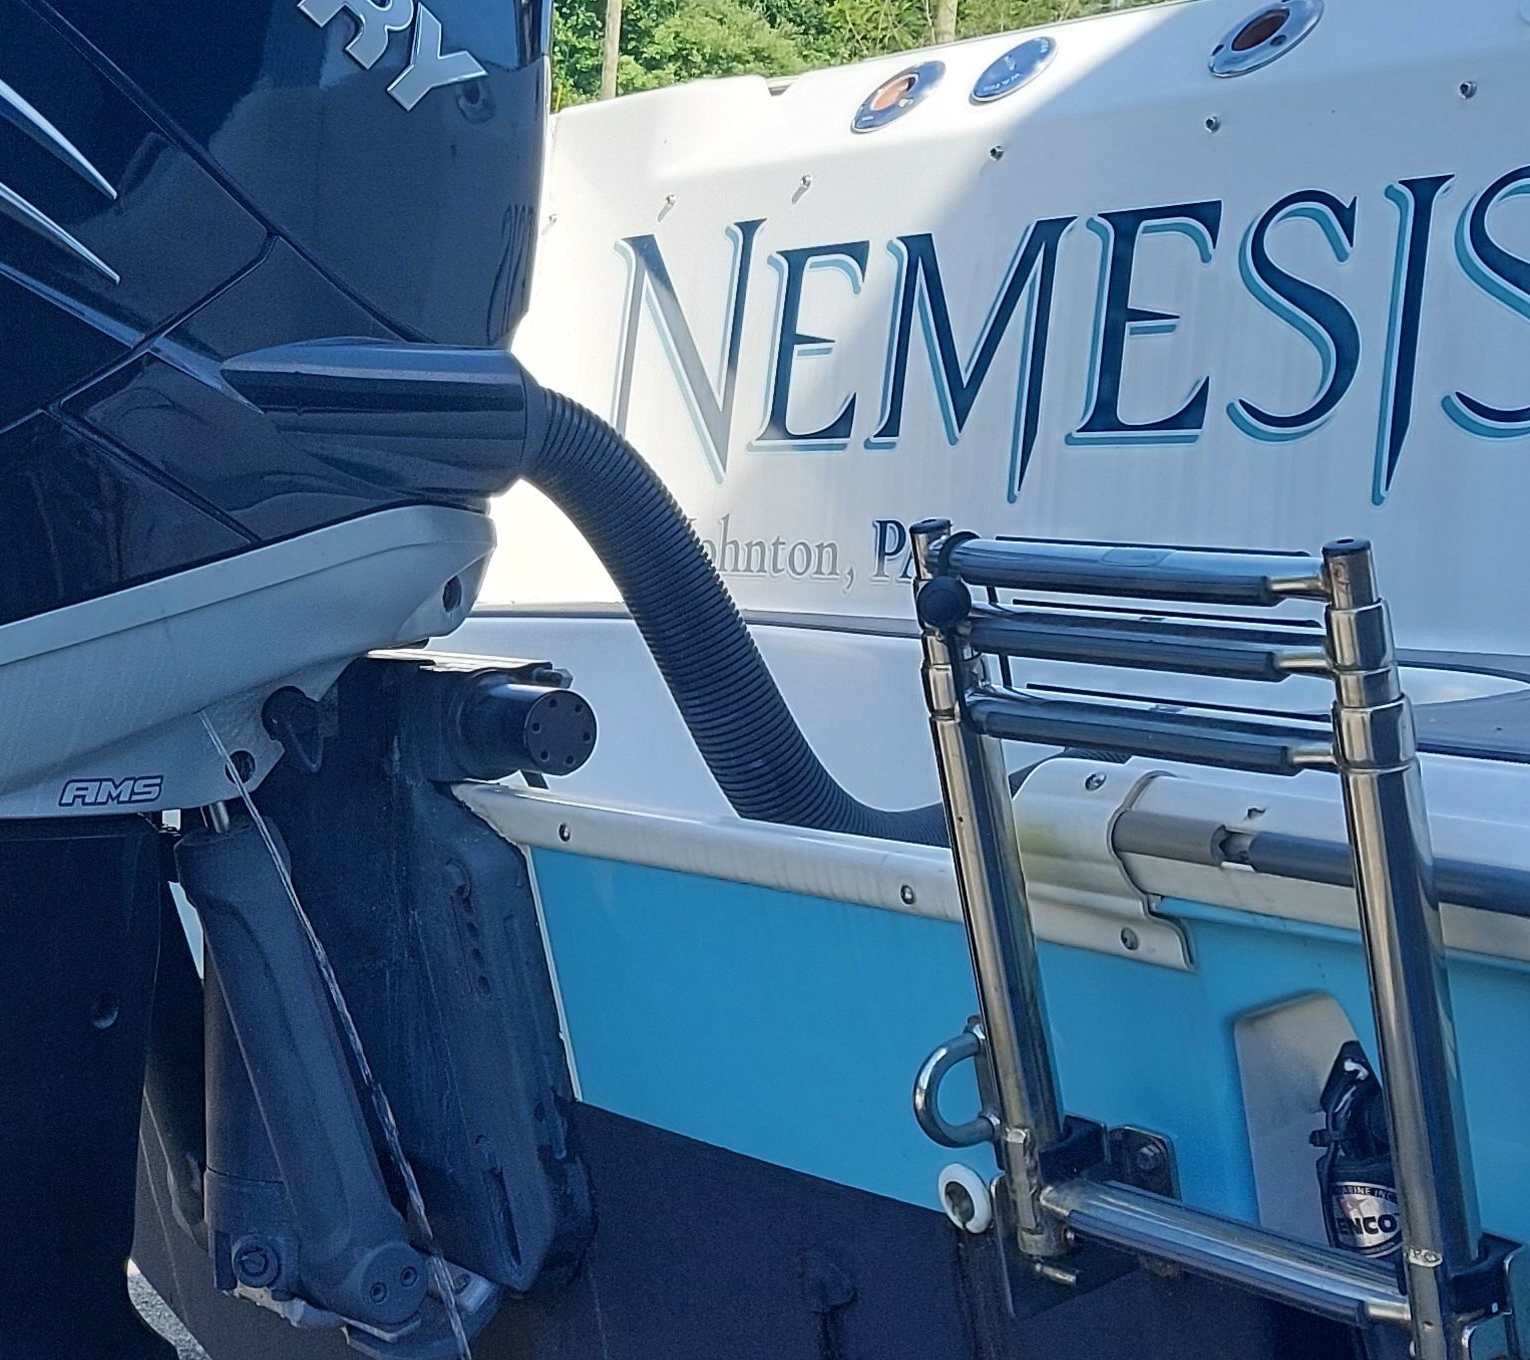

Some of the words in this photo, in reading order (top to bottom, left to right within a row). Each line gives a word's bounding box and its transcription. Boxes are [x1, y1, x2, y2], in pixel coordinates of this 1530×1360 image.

[687, 512, 856, 594] ohnton,
[872, 518, 917, 584] P
[58, 774, 164, 808] AMS
[1336, 1213, 1398, 1235] ENCO
